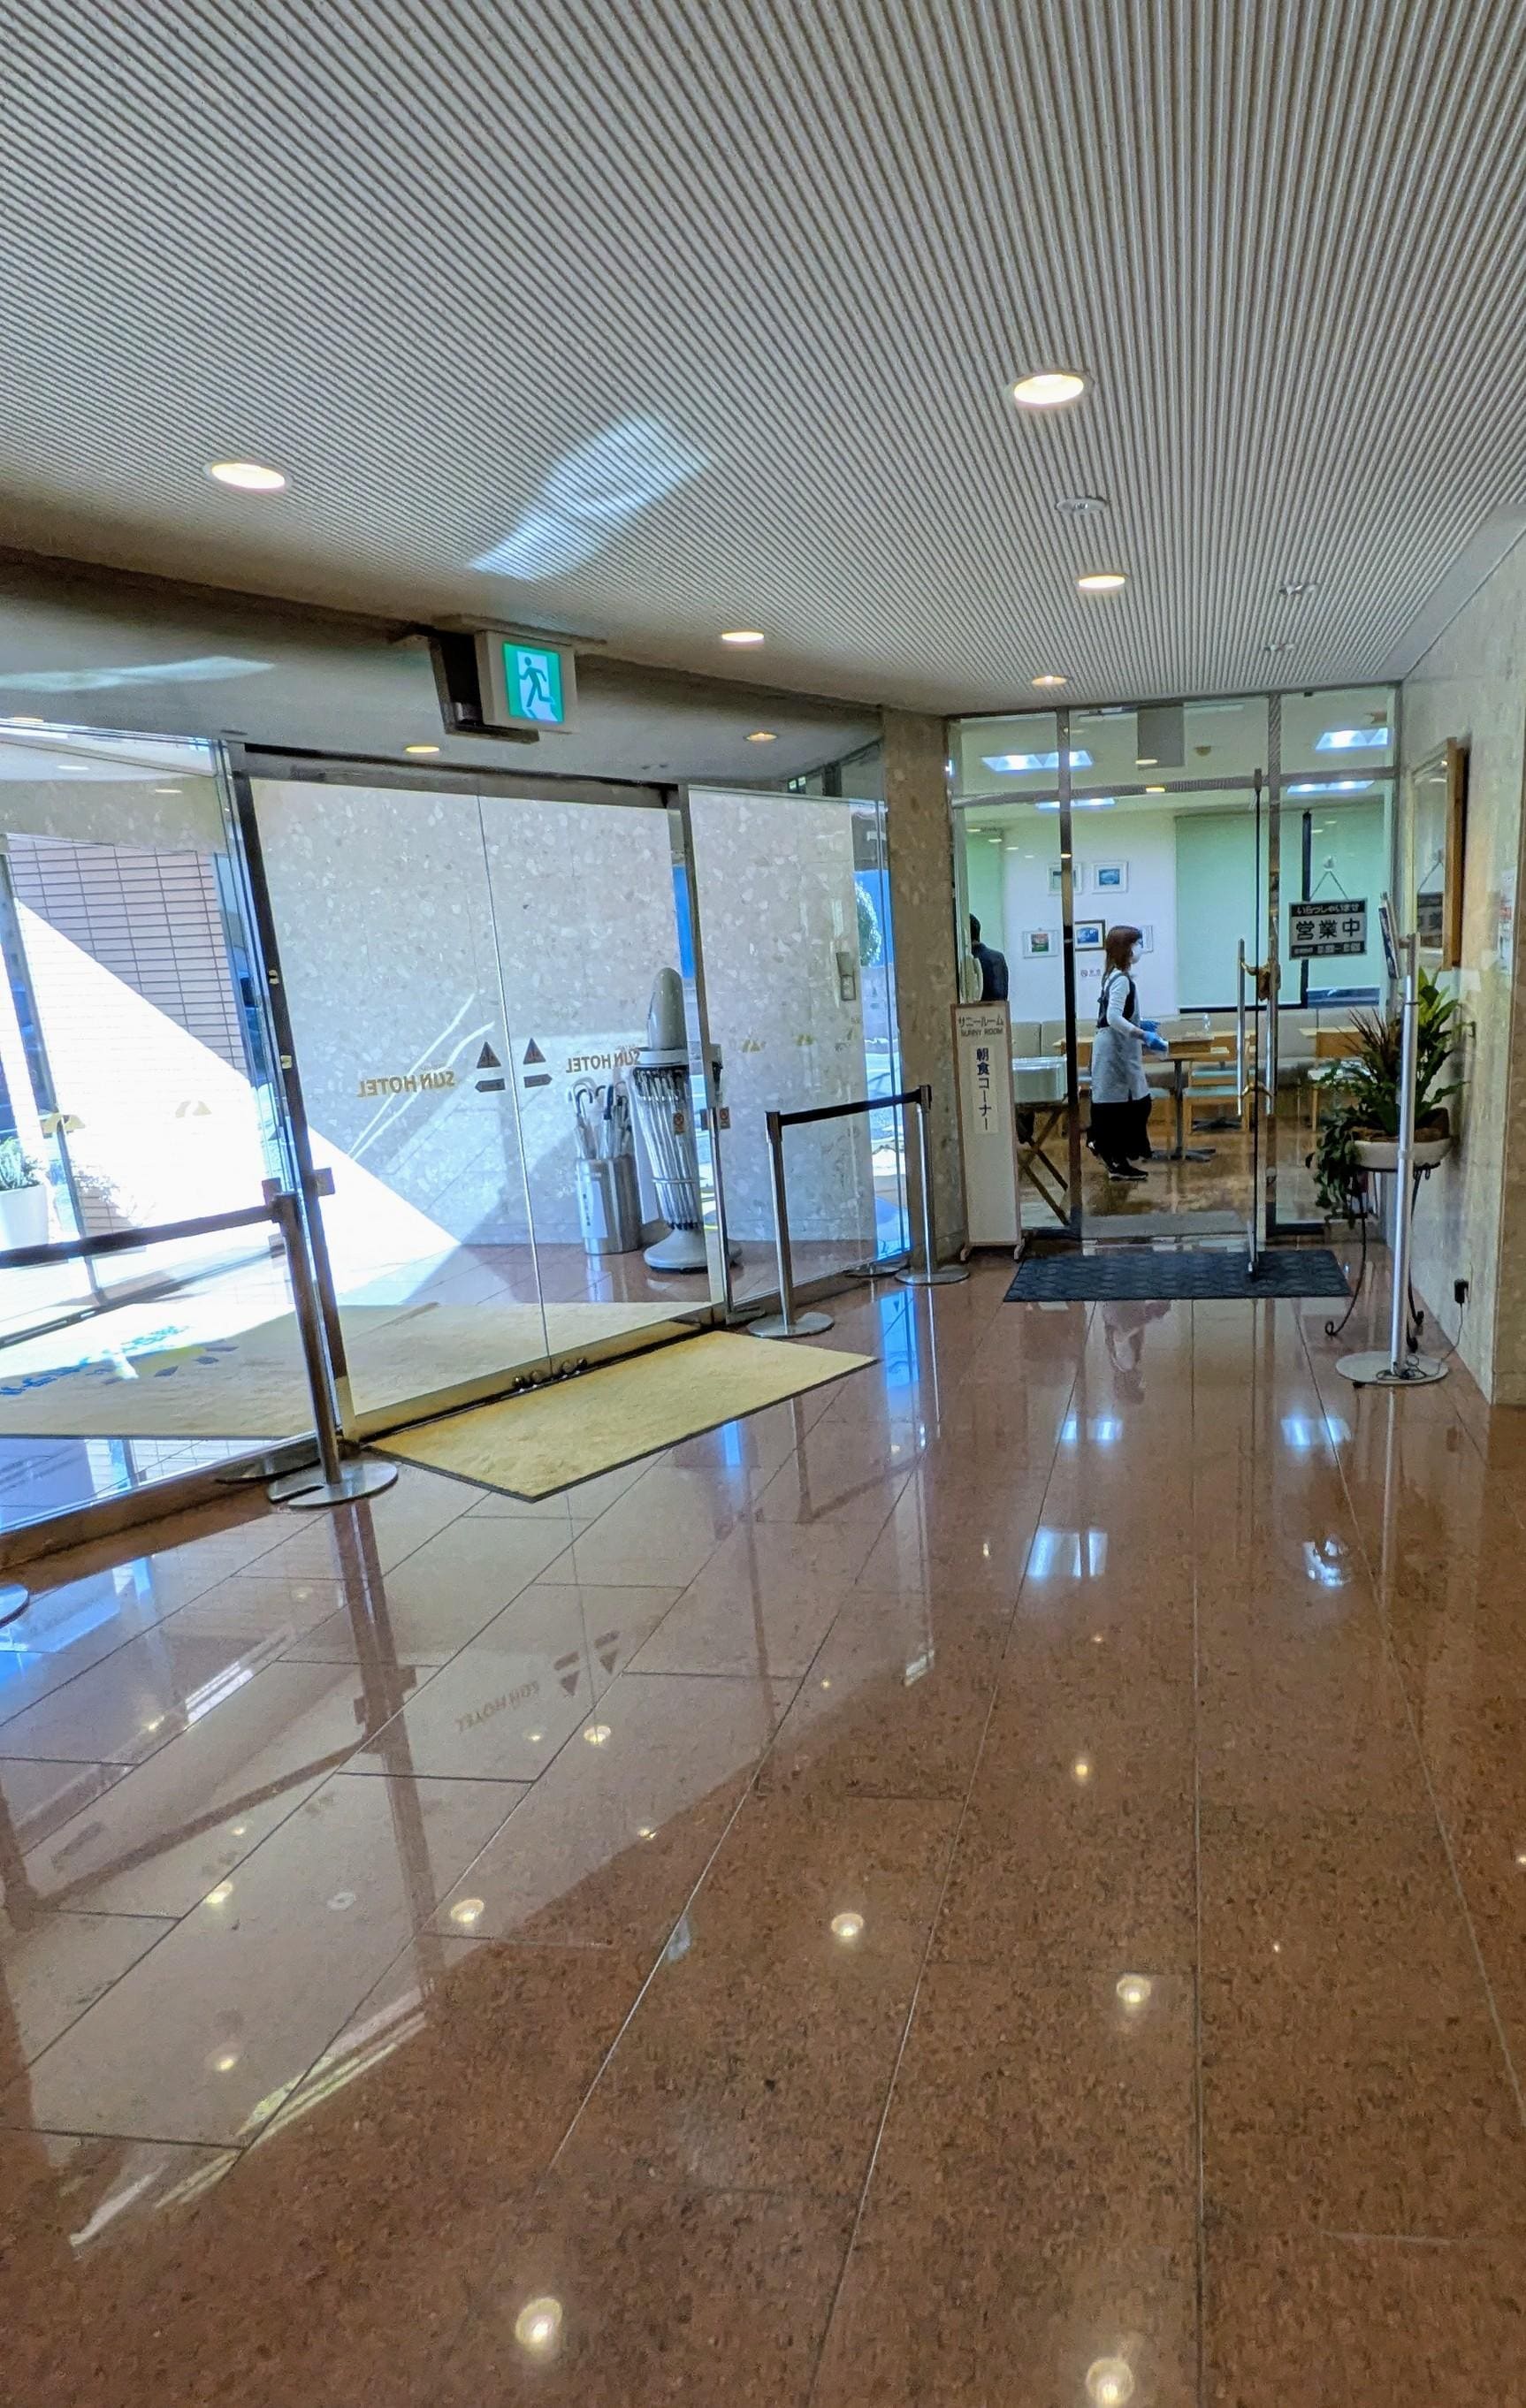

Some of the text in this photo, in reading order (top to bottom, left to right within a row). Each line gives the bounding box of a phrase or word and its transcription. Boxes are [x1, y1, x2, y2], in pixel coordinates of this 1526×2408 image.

[1296, 918, 1360, 941] 営業中
[958, 1014, 1004, 1027] サニールーム
[976, 1048, 991, 1131] 朝食コーナー
